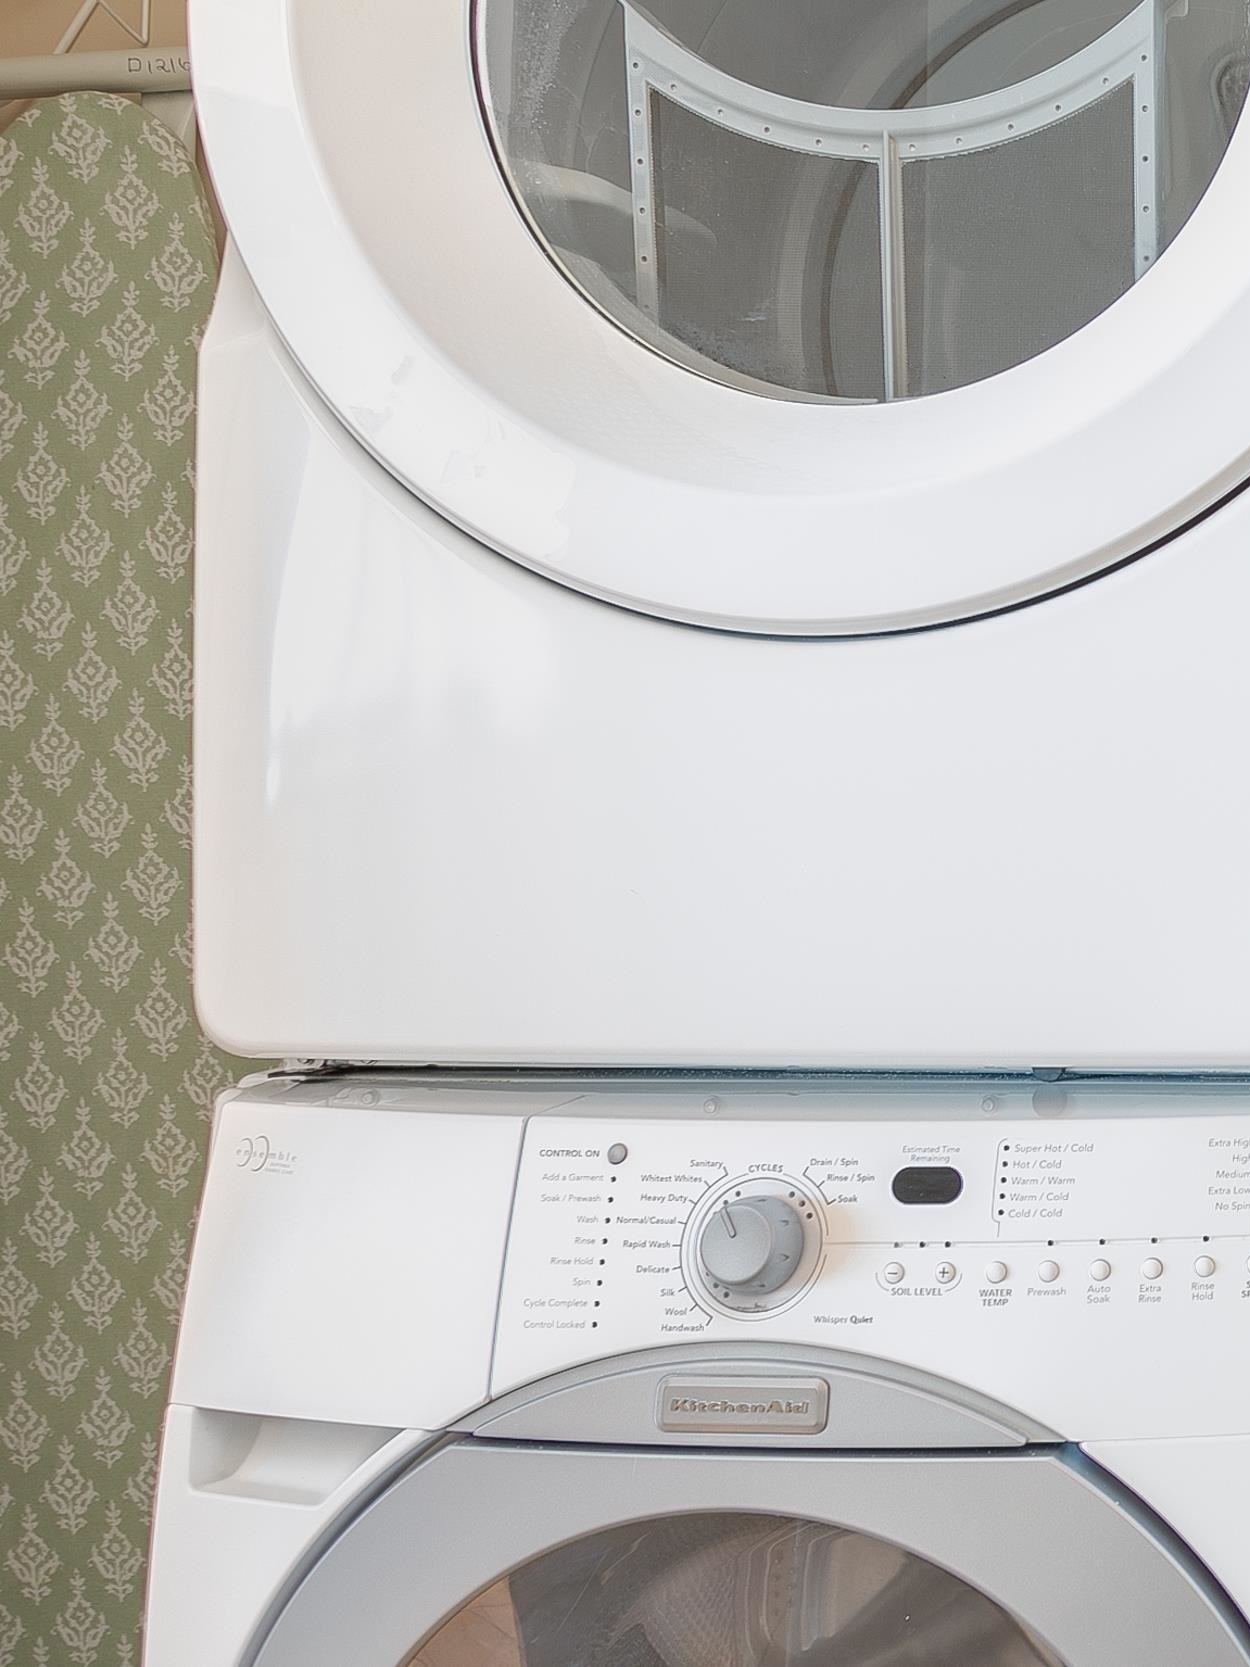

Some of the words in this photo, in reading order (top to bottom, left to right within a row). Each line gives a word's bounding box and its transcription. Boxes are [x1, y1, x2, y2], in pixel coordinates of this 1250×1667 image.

[1209, 1139, 1230, 1147] Extra
[902, 1145, 939, 1153] Estimated
[1014, 1144, 1042, 1154] Super
[1044, 1144, 1062, 1153] Hot
[1070, 1143, 1094, 1153] Cold
[539, 1149, 583, 1158] CONTROL
[585, 1149, 600, 1158] ON
[841, 1159, 858, 1167] Spin
[910, 1154, 950, 1164] Remaining
[690, 1160, 724, 1169] Sanitary
[748, 1164, 783, 1173] CYCLES
[1012, 1160, 1030, 1169] Hot
[1039, 1160, 1062, 1169] Cold
[542, 1173, 560, 1182] Add
[568, 1173, 604, 1182] Garment
[640, 1174, 672, 1182] Whitest
[674, 1175, 702, 1183] Whites
[827, 1174, 848, 1182] Rinse
[857, 1174, 875, 1183] Spin
[1011, 1176, 1039, 1185] Warm
[1047, 1176, 1076, 1185] Warm
[1208, 1186, 1230, 1195] Extra
[541, 1194, 560, 1202] Soak
[568, 1194, 602, 1202] Prewash
[640, 1193, 666, 1204] Heavy
[668, 1193, 688, 1204] Duty
[838, 1195, 857, 1203] Soak
[1009, 1192, 1037, 1202] Warm
[1046, 1192, 1070, 1201] Cold
[1215, 1202, 1229, 1210] No
[1232, 1202, 1250, 1212] Spin
[1008, 1209, 1031, 1218] Cold
[1039, 1208, 1063, 1218] Cold
[577, 1215, 598, 1223] Wash
[616, 1216, 677, 1225] Normal/Casual
[575, 1237, 596, 1245] Rinse
[623, 1240, 647, 1250] Rapid
[648, 1240, 671, 1249] Wash
[551, 1257, 572, 1265] Rinse
[575, 1257, 593, 1265] Hold
[636, 1265, 670, 1273] Delicate
[573, 1278, 591, 1287] Spin
[1191, 1281, 1215, 1290] Rinse
[660, 1288, 675, 1297] Silk
[891, 1288, 912, 1296] SOIL
[914, 1288, 943, 1296] LEVEL
[979, 1288, 1013, 1297] WATER
[1027, 1287, 1066, 1295] Prewash
[1087, 1285, 1110, 1293] Auto
[1139, 1284, 1162, 1293] Extra
[1087, 1295, 1110, 1303] Soak
[1138, 1294, 1161, 1303] Rinse
[1192, 1292, 1214, 1301] Hold
[523, 1298, 546, 1309] Cycle
[547, 1298, 588, 1309] Complete
[982, 1299, 1008, 1307] TEMP
[665, 1307, 687, 1315] Wool
[523, 1320, 554, 1329] Control
[556, 1320, 586, 1329] Locked
[814, 1315, 848, 1325] Whisper
[850, 1315, 873, 1324] Quiet
[661, 1323, 704, 1332] Handwash
[670, 1398, 810, 1414] KitchenAid
